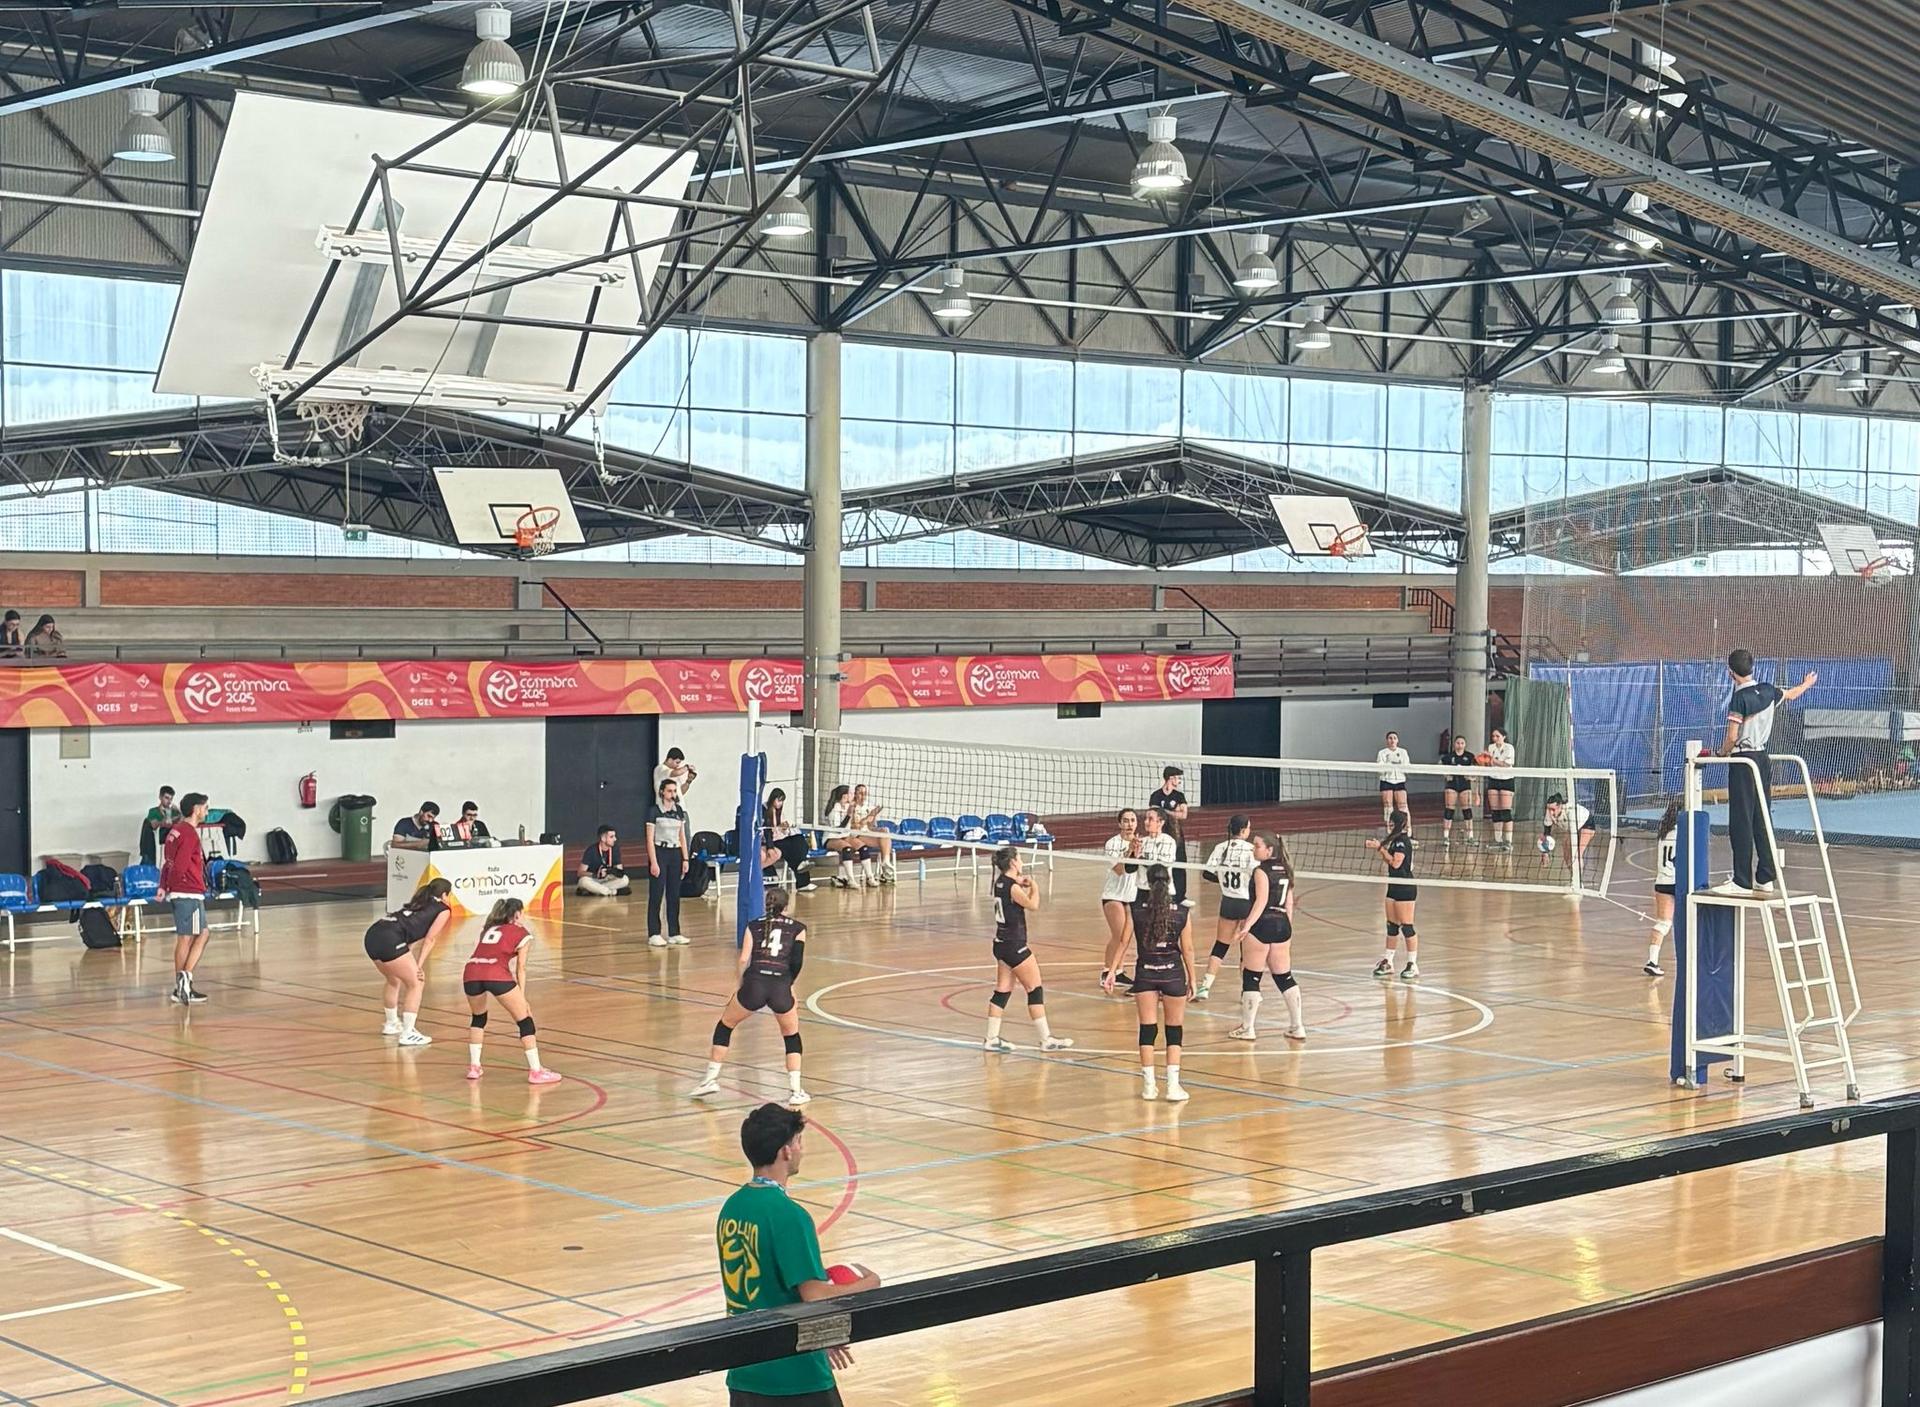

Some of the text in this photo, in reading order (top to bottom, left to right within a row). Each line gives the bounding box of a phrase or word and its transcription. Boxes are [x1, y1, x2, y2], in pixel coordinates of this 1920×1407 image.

[995, 669, 1040, 680] coimbra
[224, 679, 291, 691] coimbra
[520, 676, 578, 688] coimbra
[521, 688, 547, 700] 2025
[775, 685, 797, 695] 2025
[226, 692, 255, 705] 2025
[411, 698, 433, 706] DGES
[96, 703, 121, 712] DGES
[481, 926, 503, 945] 6
[761, 928, 783, 957] 4
